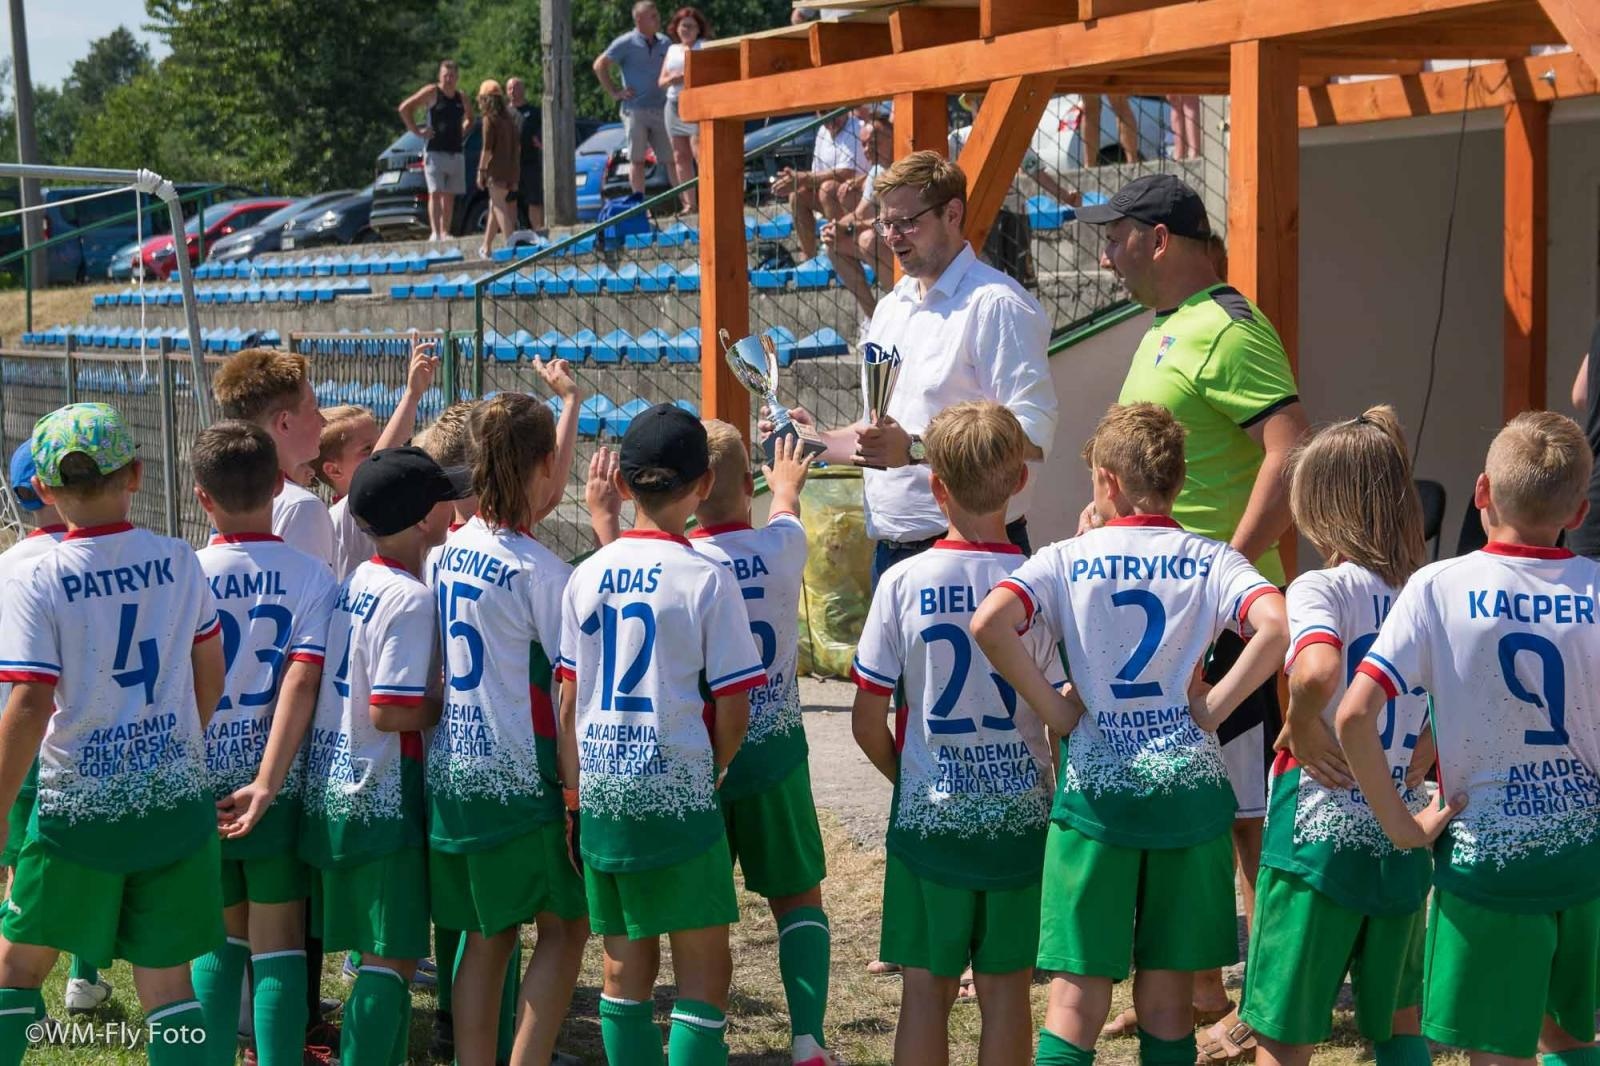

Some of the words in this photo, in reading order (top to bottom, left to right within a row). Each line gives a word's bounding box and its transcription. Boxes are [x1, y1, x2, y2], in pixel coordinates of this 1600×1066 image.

[62, 557, 175, 602] PATRYK
[207, 571, 287, 599] KAMIL
[433, 545, 520, 592] KSINEK
[598, 562, 662, 594] ADAŚ
[1468, 590, 1595, 624] KACPER
[112, 603, 160, 705] 4
[580, 602, 655, 712] 12
[1111, 589, 1166, 699] 2
[1498, 632, 1569, 746] 9
[585, 722, 657, 742] AKADEMIA
[939, 741, 1030, 762] AKADEMIA
